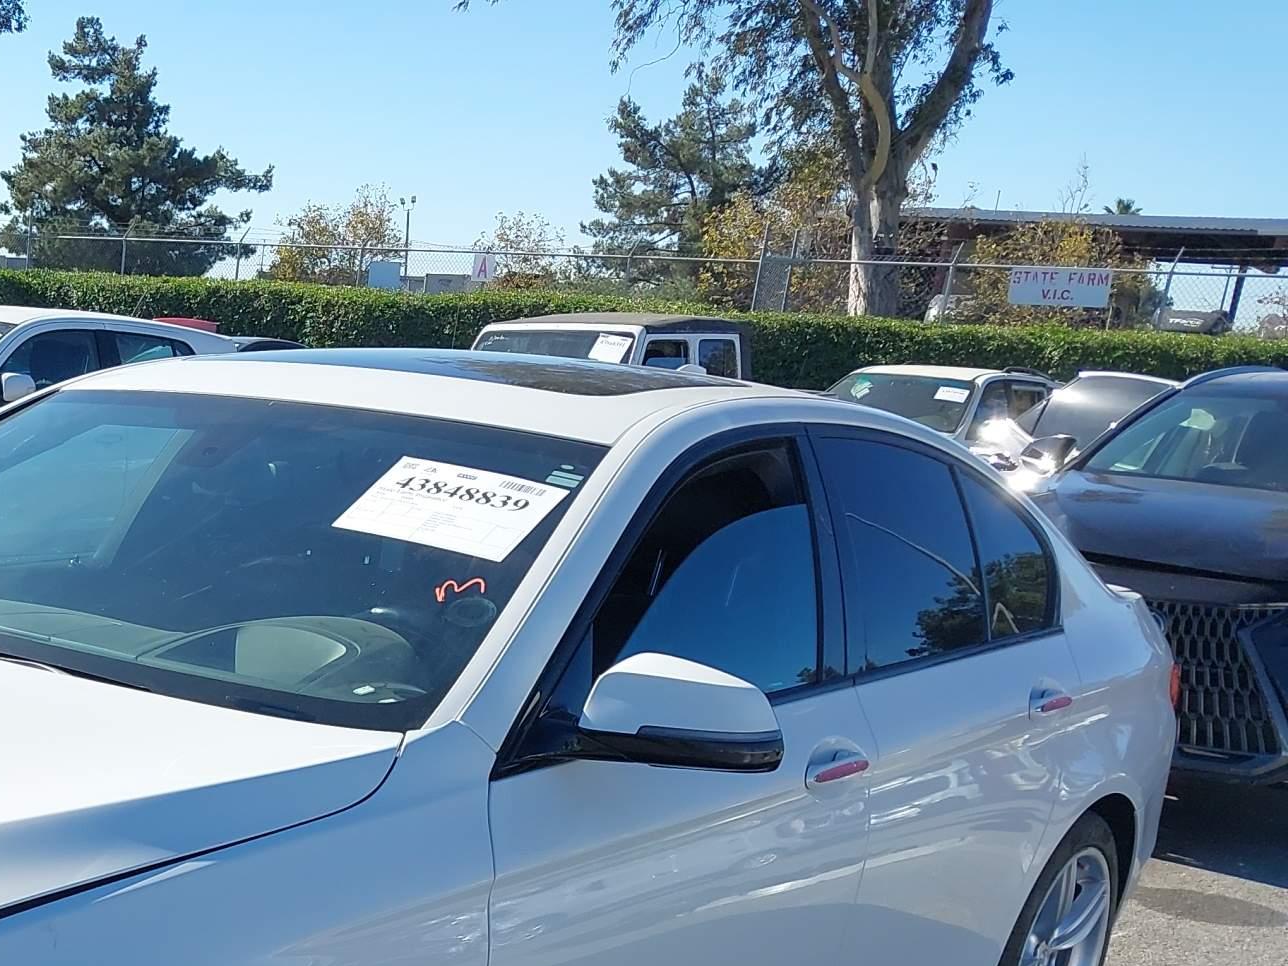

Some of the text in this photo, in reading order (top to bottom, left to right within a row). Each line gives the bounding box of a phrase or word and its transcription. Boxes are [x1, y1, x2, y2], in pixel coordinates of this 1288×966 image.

[477, 255, 487, 278] A
[1012, 270, 1110, 287] STATE FARM
[1041, 288, 1074, 300] V.I.C.
[395, 475, 531, 512] 43848839
